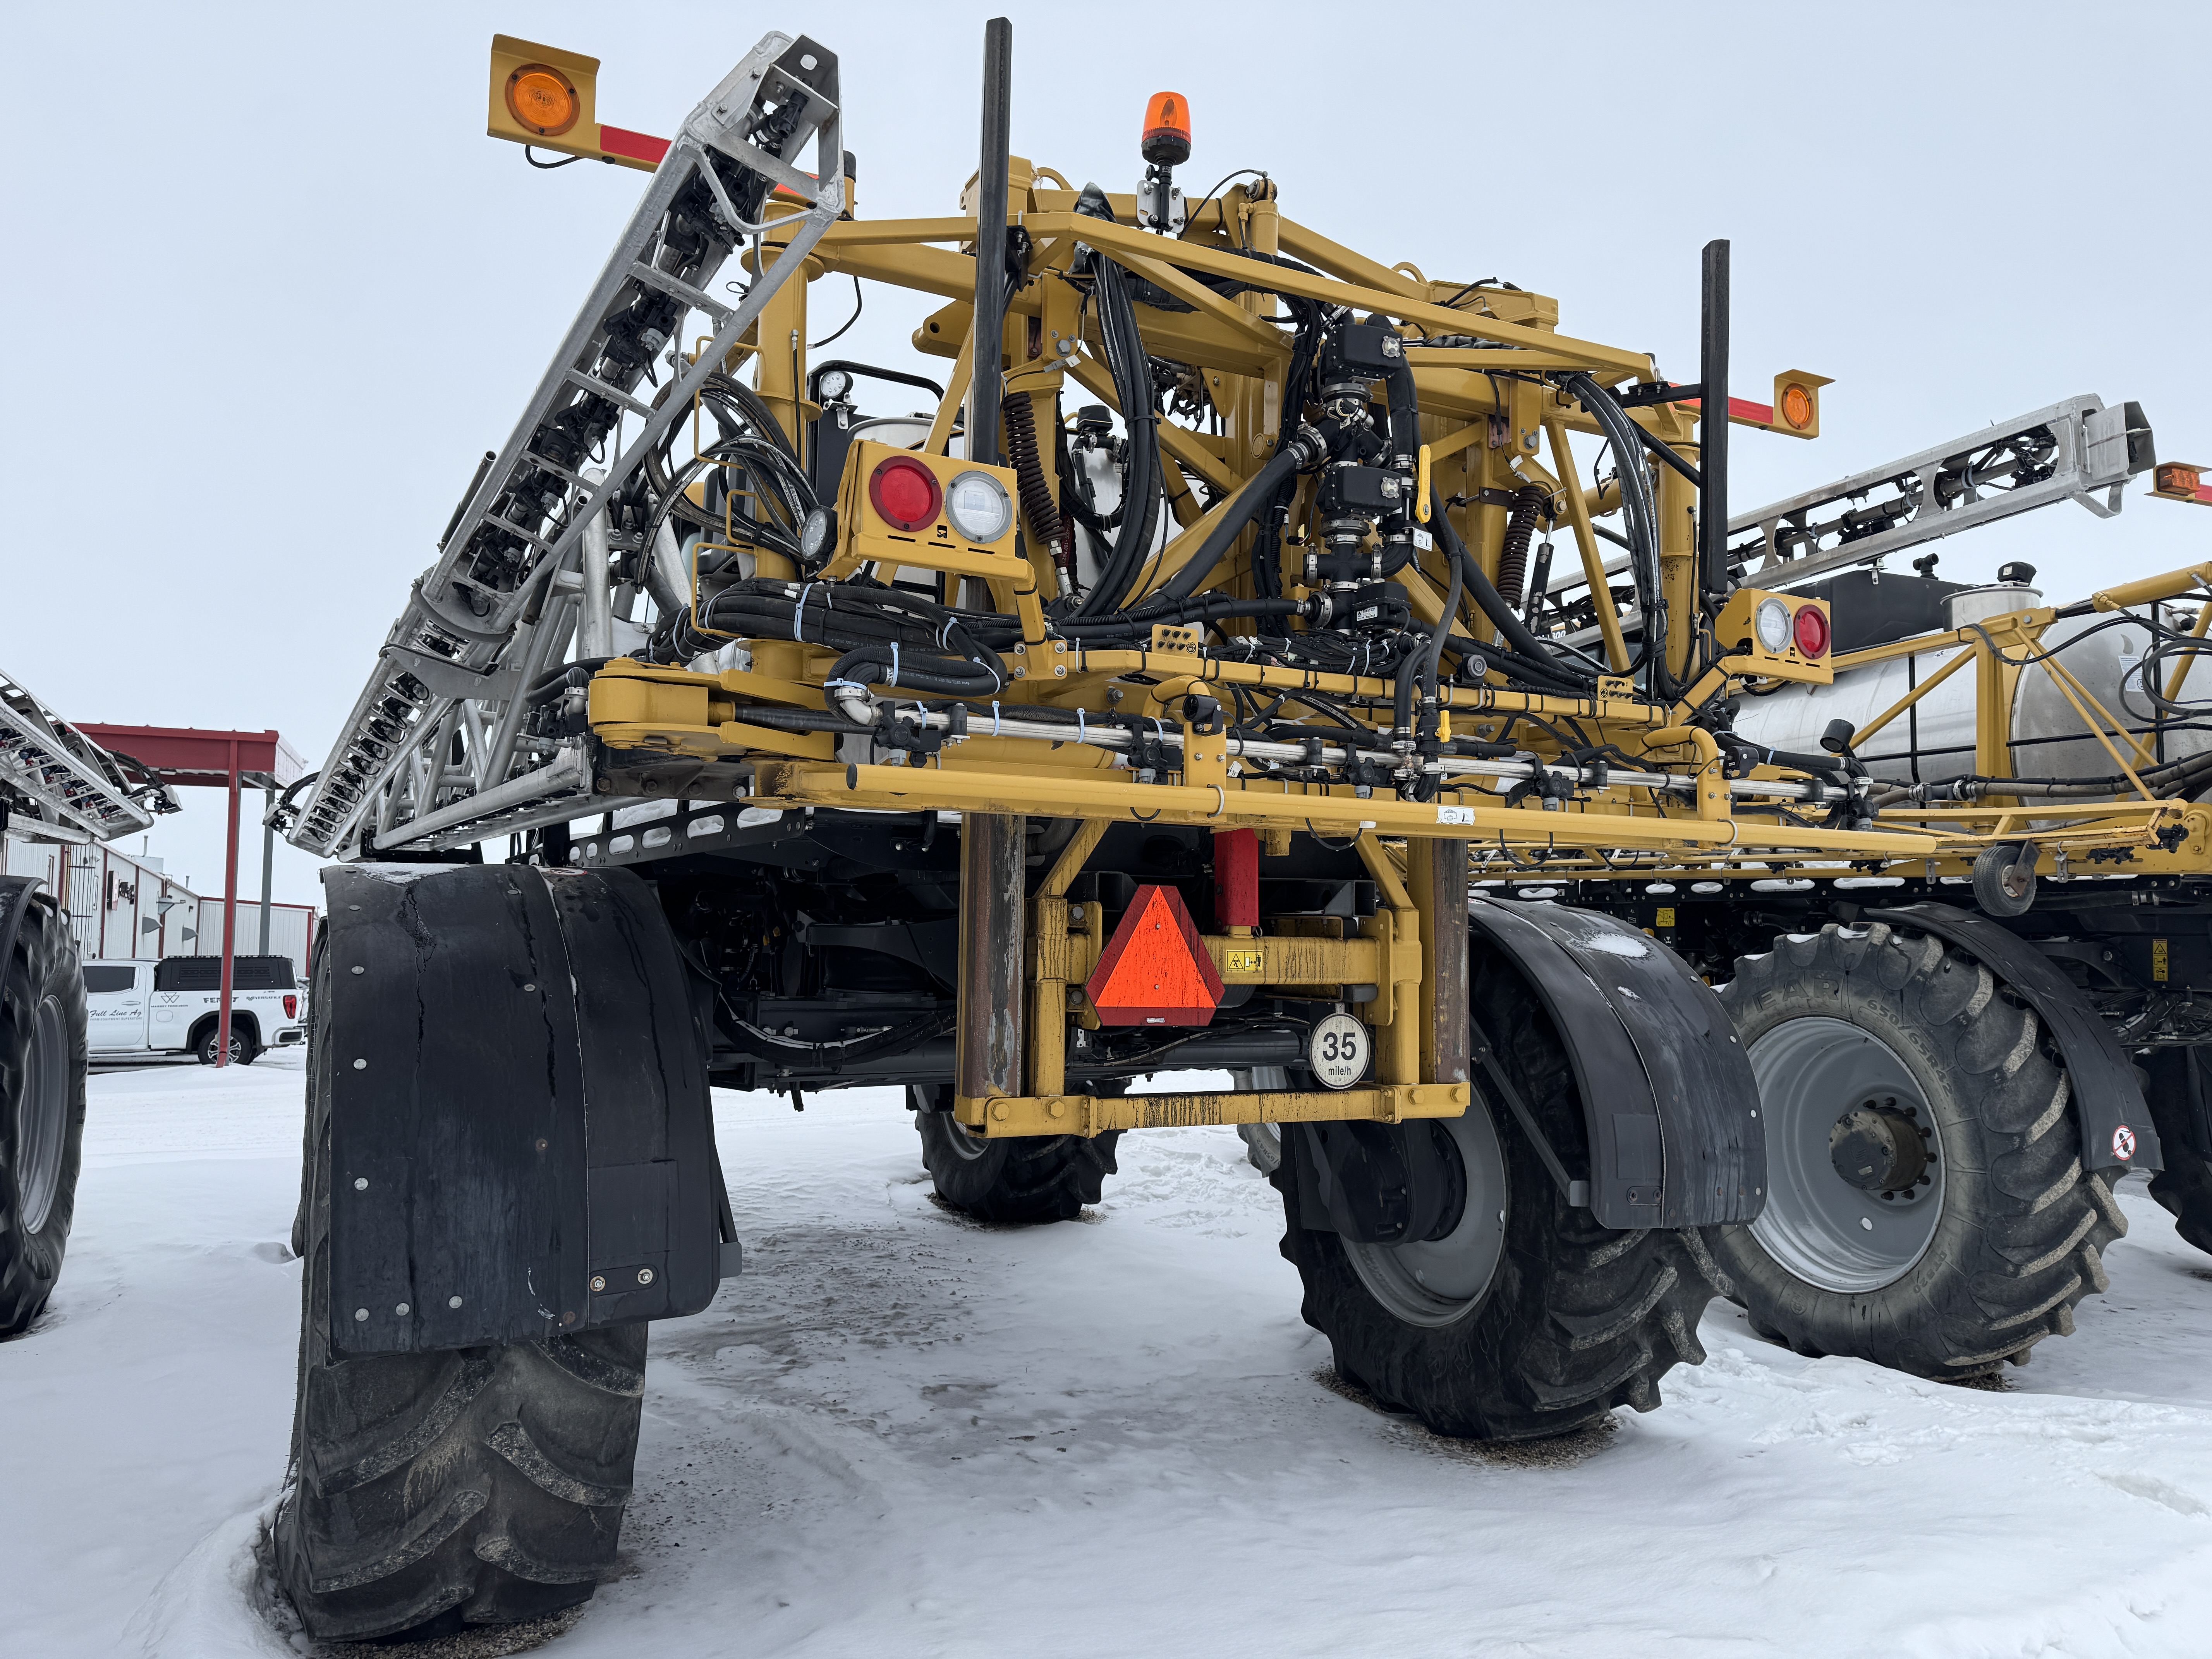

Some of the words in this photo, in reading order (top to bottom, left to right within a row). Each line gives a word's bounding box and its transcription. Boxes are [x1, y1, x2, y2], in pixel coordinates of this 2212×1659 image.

[90, 1010, 106, 1018] Full
[129, 1009, 142, 1018] Ag
[1322, 1032, 1356, 1061] 35
[1867, 999, 1953, 1097] 650/65R42
[1328, 1066, 1351, 1075] mile/h
